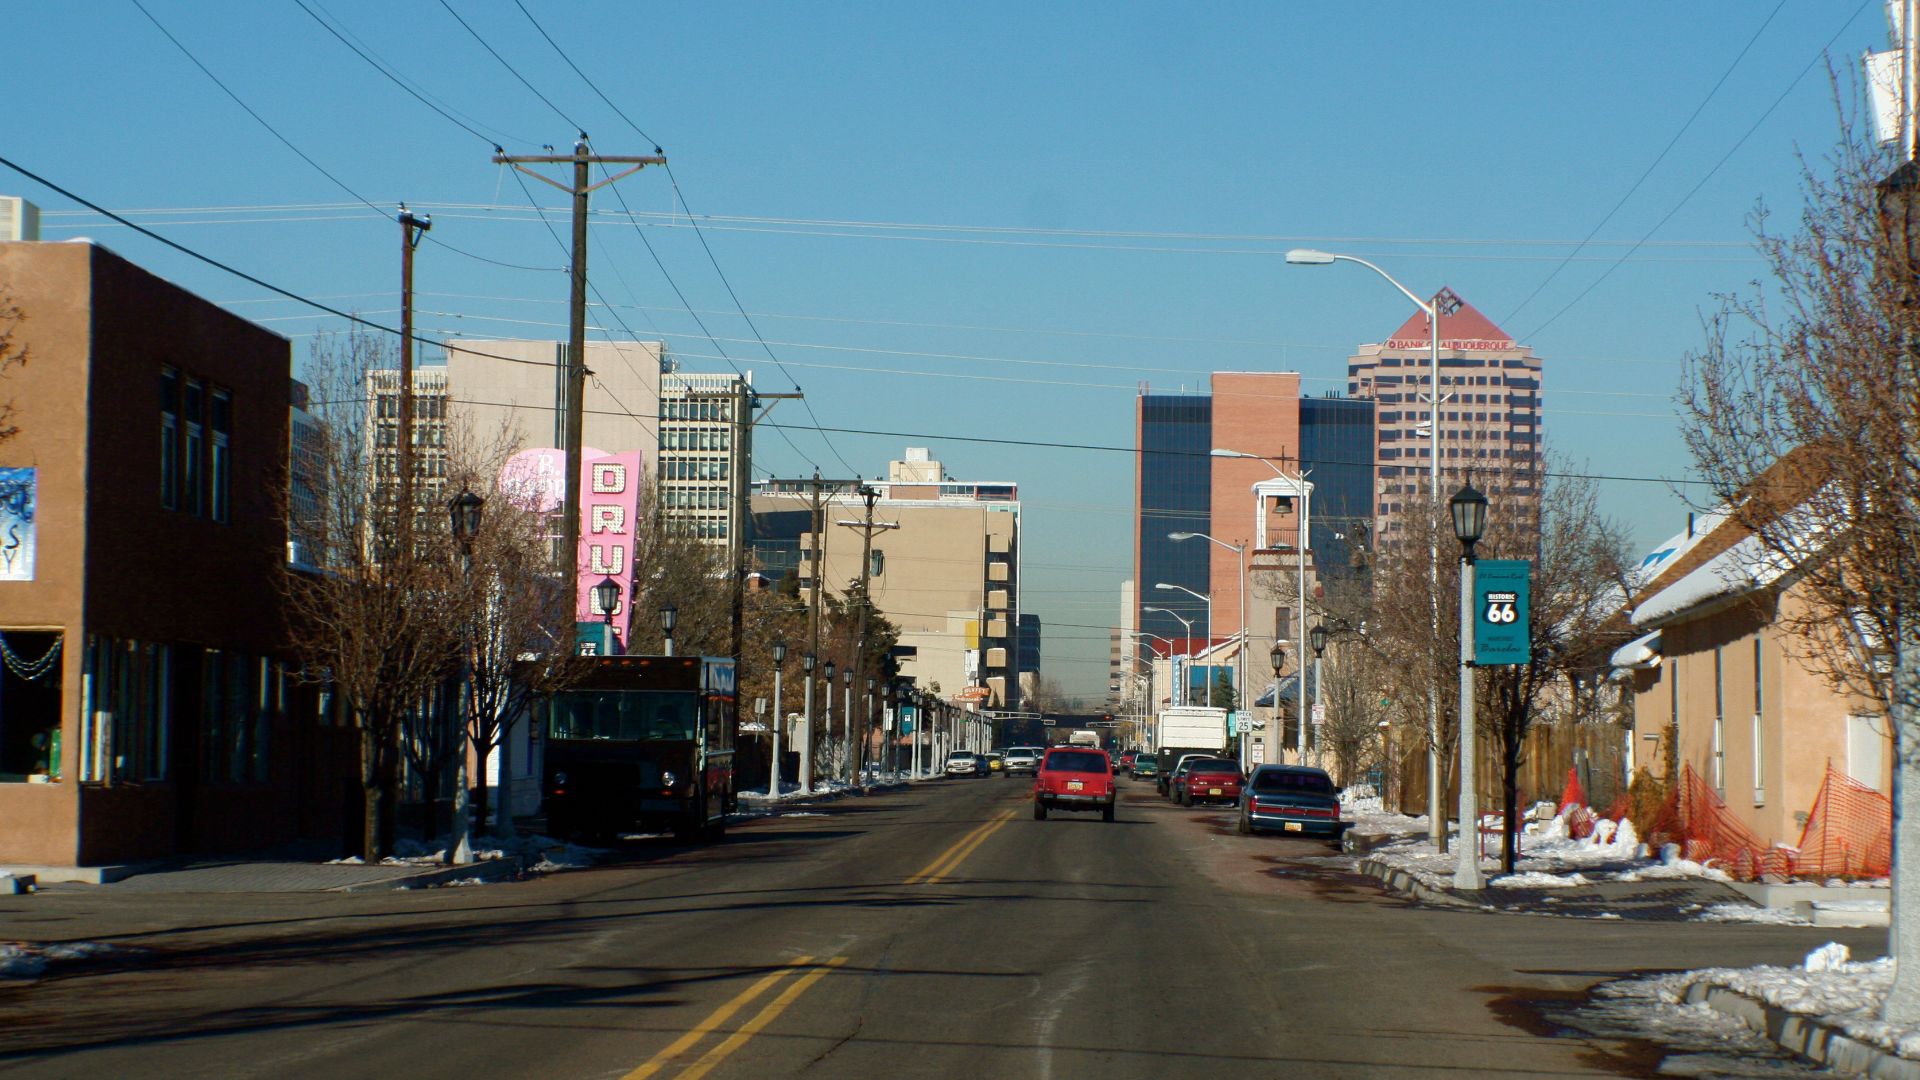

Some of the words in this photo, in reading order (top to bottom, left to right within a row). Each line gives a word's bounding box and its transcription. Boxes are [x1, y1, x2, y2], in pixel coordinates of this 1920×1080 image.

[1398, 341, 1423, 349] BANK
[1441, 341, 1509, 350] ALBUQUERQUE
[589, 462, 627, 636] DRUG
[1487, 603, 1515, 623] 66
[1238, 721, 1249, 731] 25
